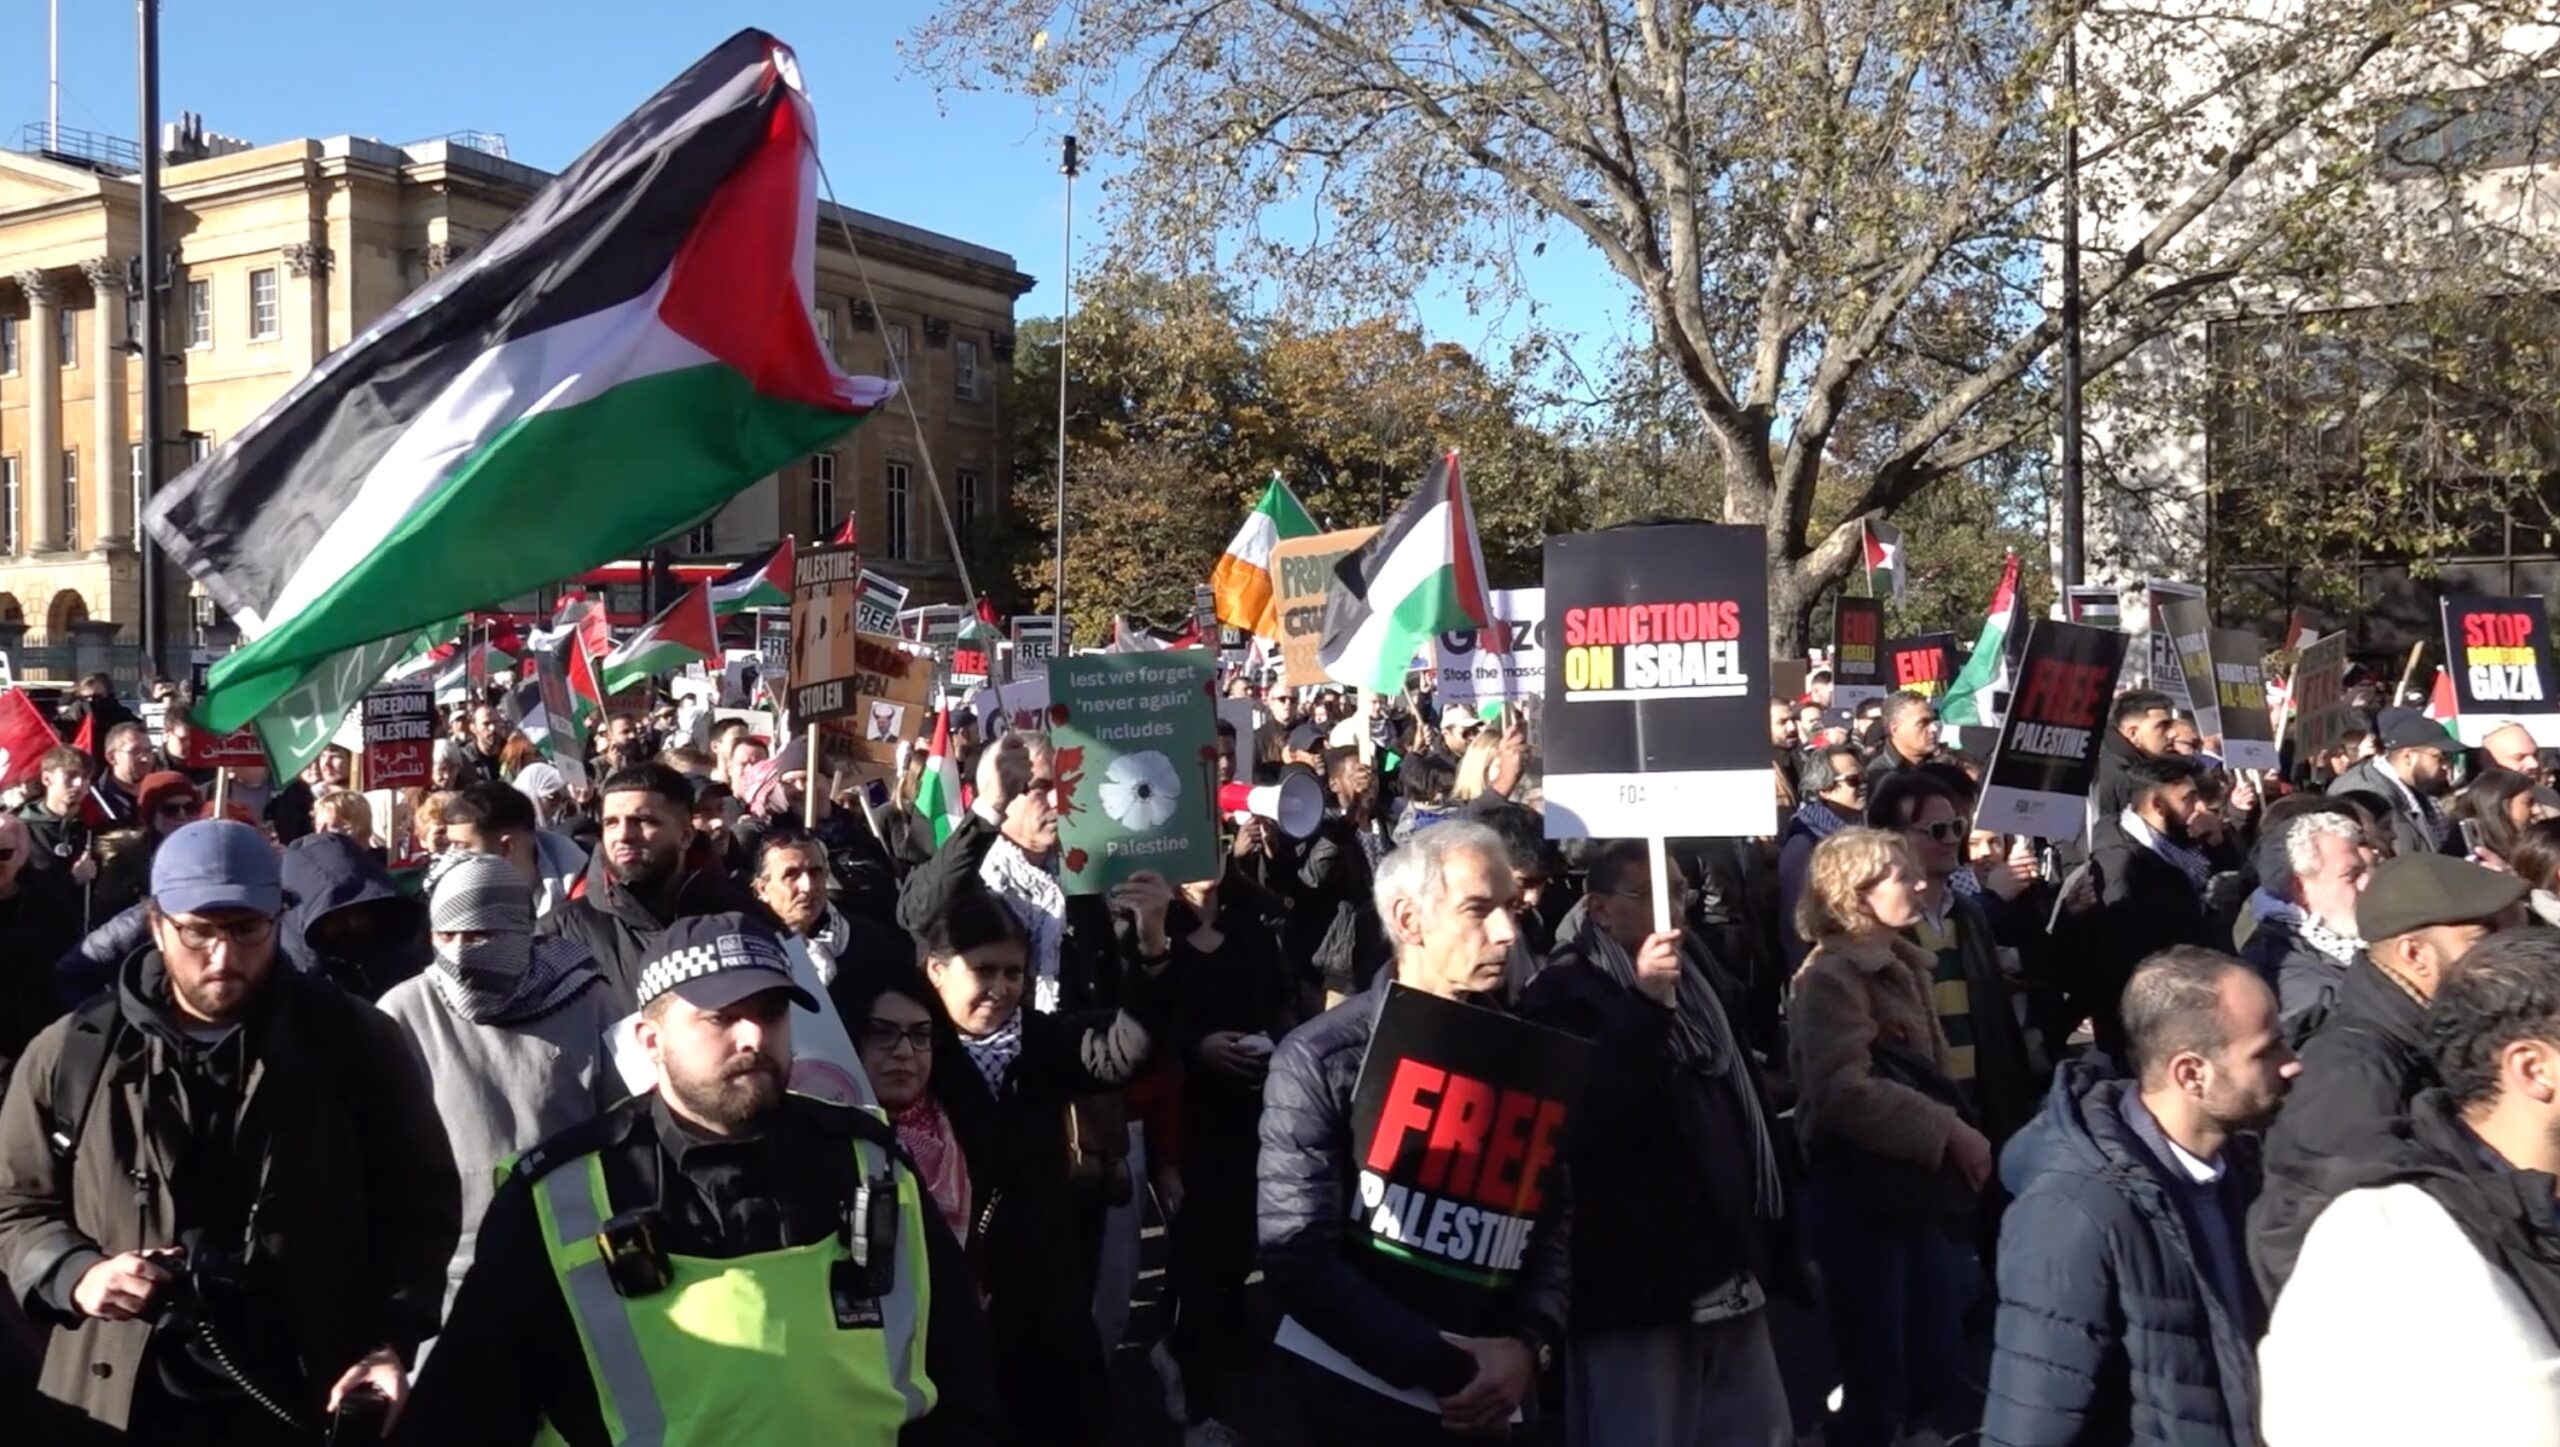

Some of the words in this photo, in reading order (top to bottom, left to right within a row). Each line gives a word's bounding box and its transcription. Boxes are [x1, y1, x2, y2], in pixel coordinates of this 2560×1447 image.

[796, 551, 855, 587] PALESTINE
[859, 603, 893, 634] REE
[1565, 601, 1741, 645] SANCTIONS
[2464, 612, 2533, 647] STOP
[955, 649, 989, 674] REE
[1070, 672, 1107, 688] lest
[1108, 672, 1135, 685] we
[1138, 665, 1196, 685] forget
[1443, 667, 1472, 681] Stop
[1475, 666, 1498, 680] the
[1565, 646, 1614, 690] ON
[1623, 640, 1748, 689] ISRAEL
[1896, 647, 1950, 685] END
[798, 681, 844, 719] STOLEN
[2021, 657, 2112, 727] FREE
[2468, 665, 2544, 701] GAZA
[366, 695, 428, 717] FREEDOM
[366, 720, 431, 742] PALESTINE
[2010, 721, 2092, 759] PALESTINE
[1106, 836, 1189, 858] Palestine
[1367, 1057, 1567, 1213] FREE
[1350, 1169, 1536, 1271] PALESTINE
